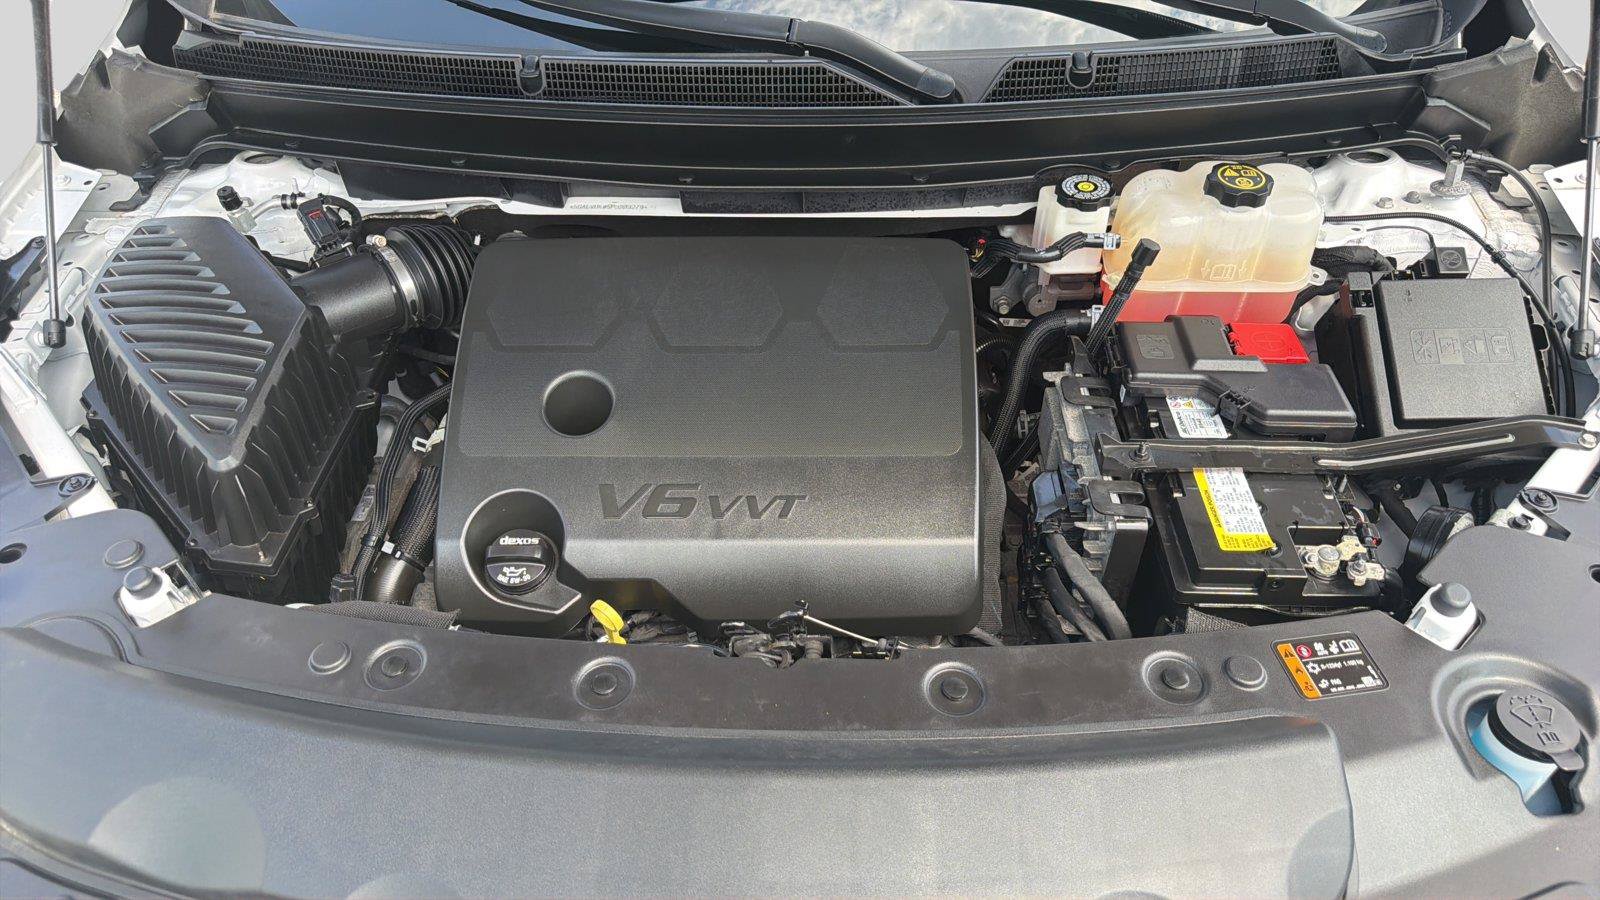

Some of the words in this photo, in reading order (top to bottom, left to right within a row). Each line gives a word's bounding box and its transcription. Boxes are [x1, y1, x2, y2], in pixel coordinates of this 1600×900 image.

[599, 483, 701, 519] V6
[708, 494, 809, 519] VVT
[499, 535, 541, 545] dexos
